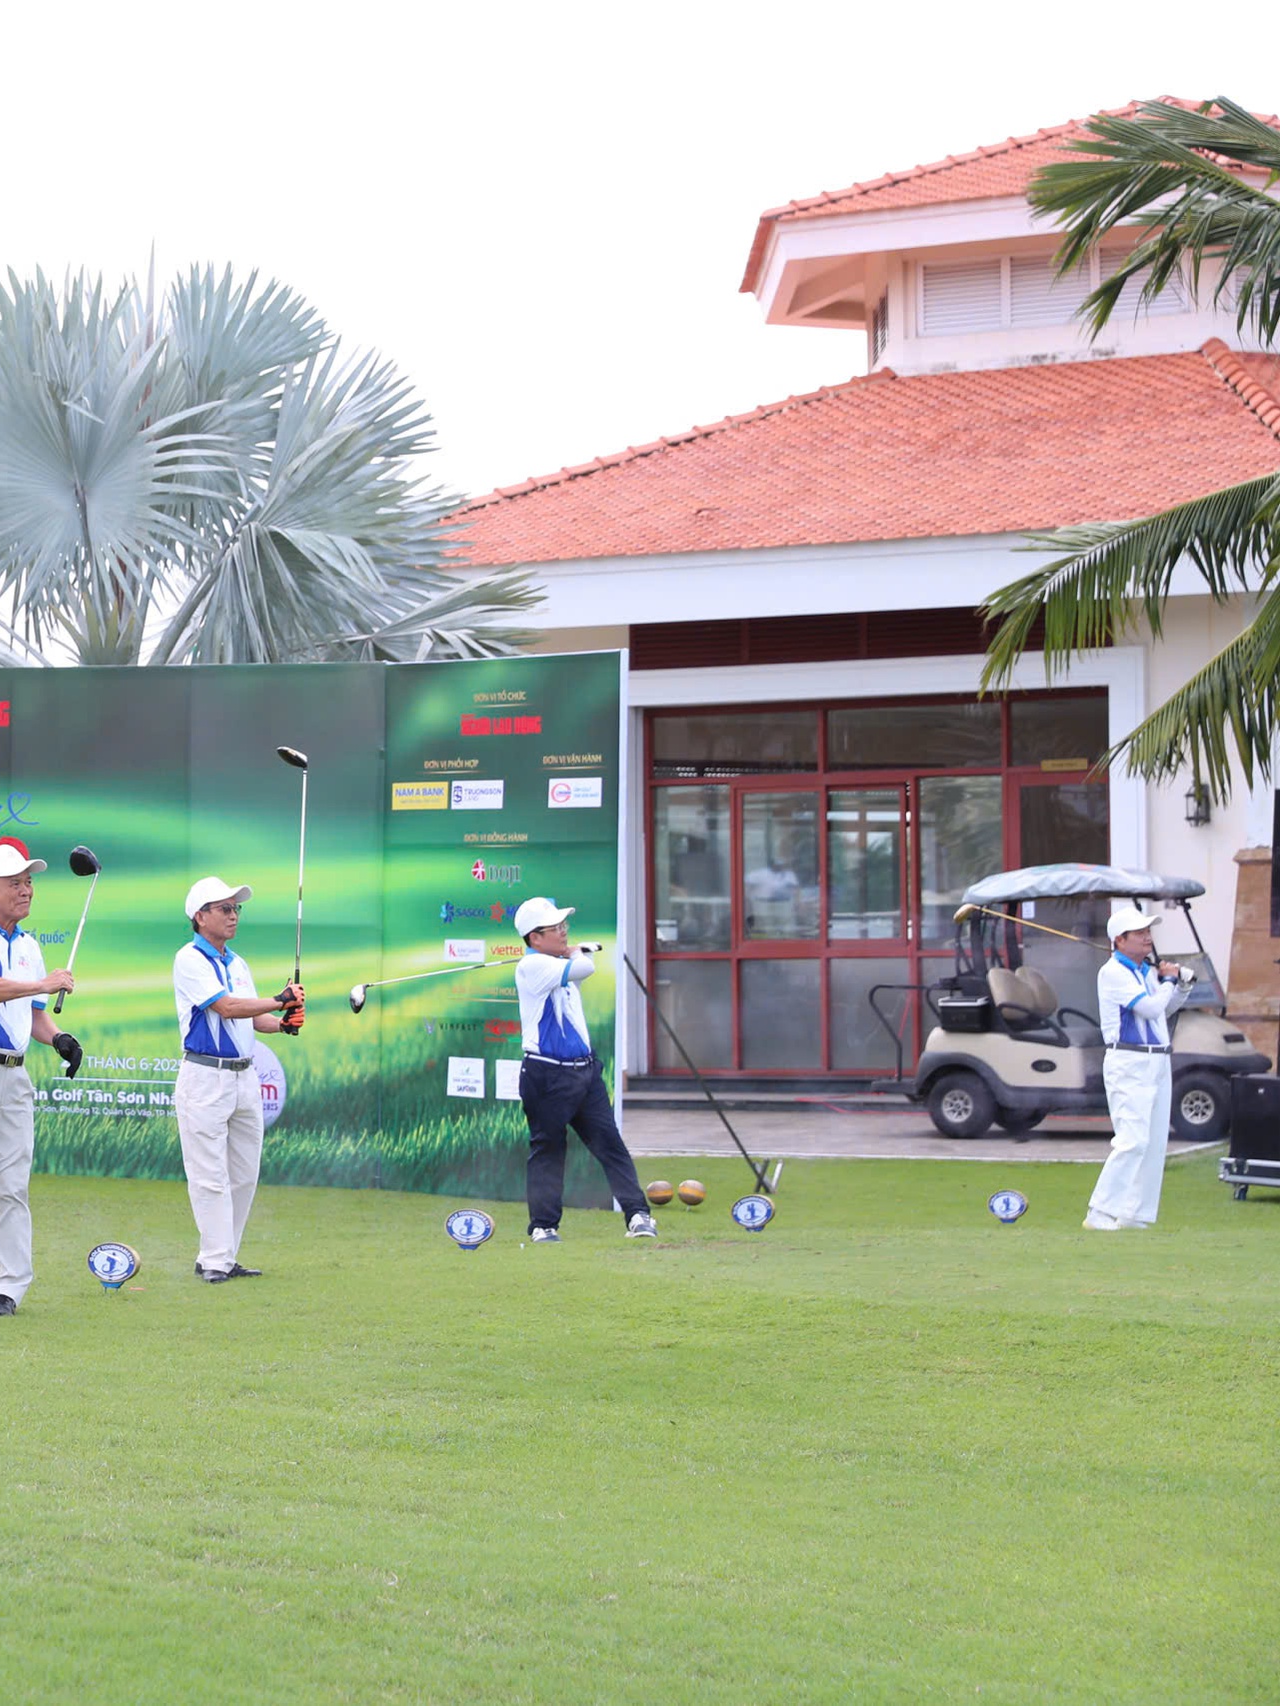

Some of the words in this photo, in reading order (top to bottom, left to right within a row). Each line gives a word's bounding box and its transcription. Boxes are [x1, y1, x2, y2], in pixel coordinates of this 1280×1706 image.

[86, 1055, 136, 1071] THÁNG
[32, 1086, 48, 1101] ân
[52, 1087, 83, 1101] Golf
[86, 1089, 113, 1103] Tân
[116, 1090, 144, 1104] Sơn
